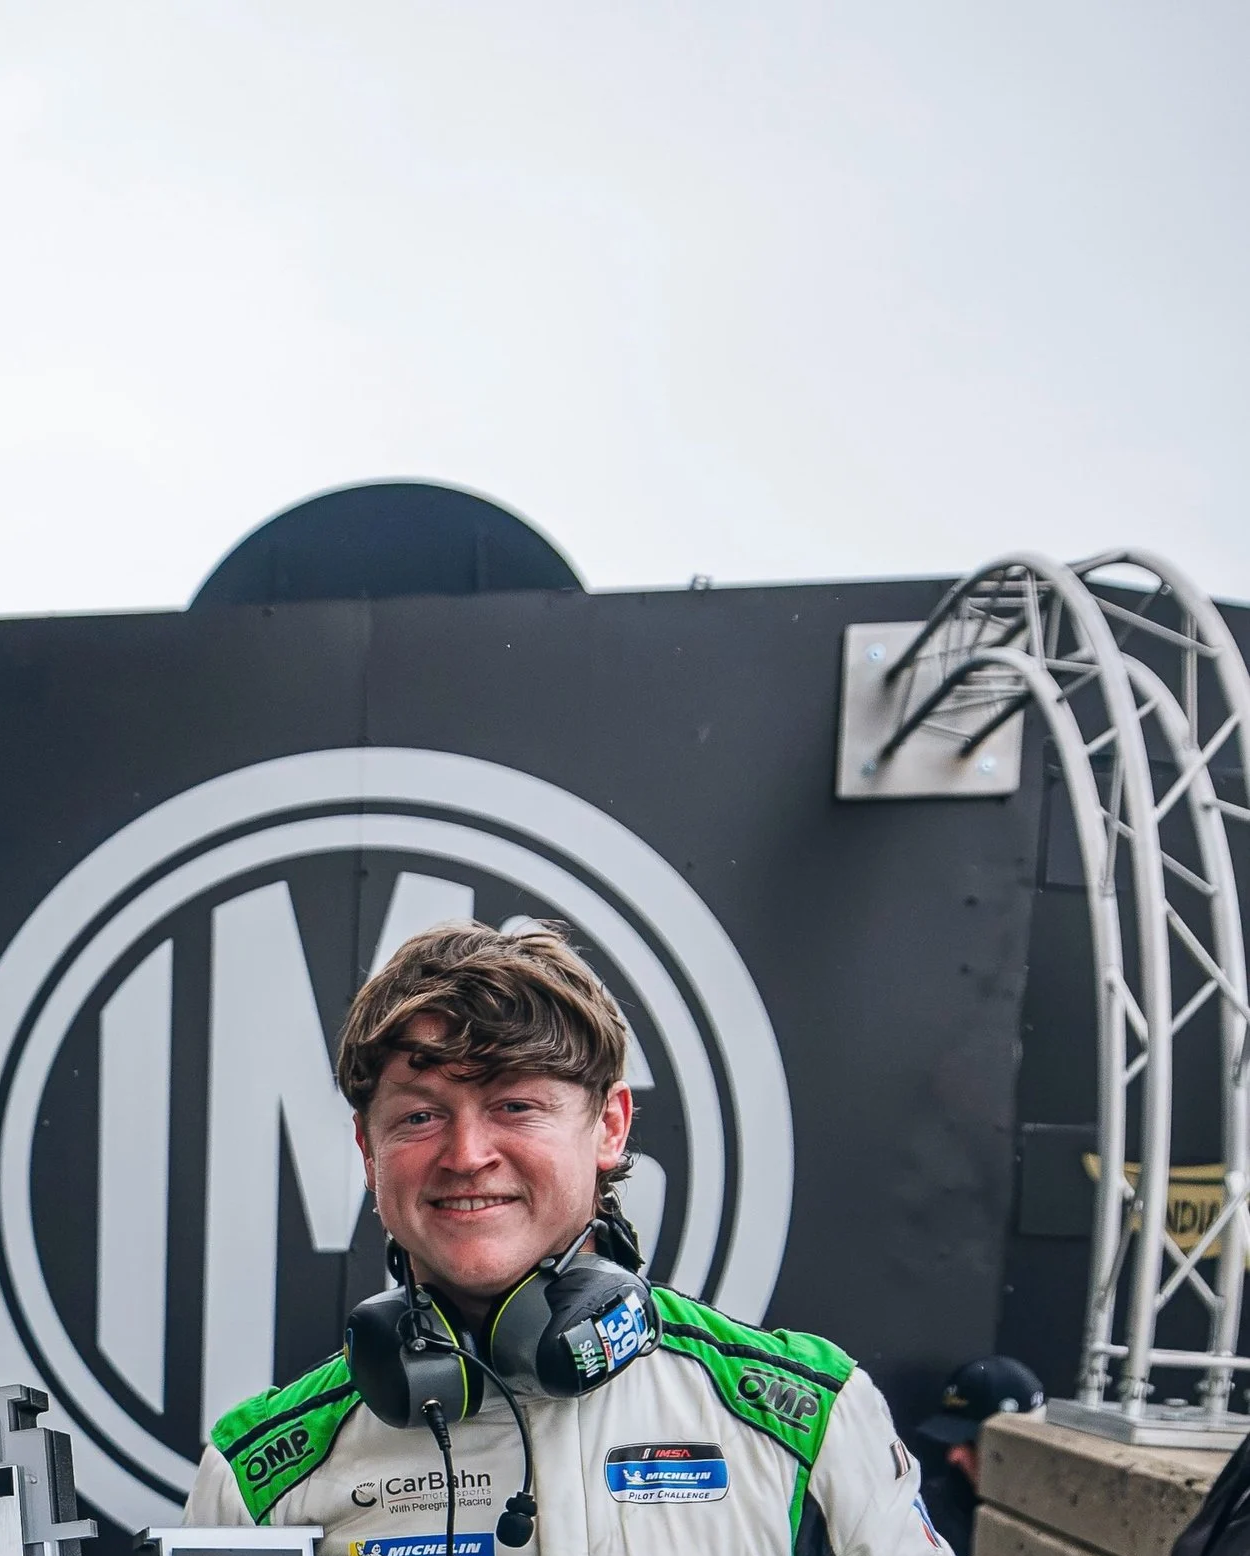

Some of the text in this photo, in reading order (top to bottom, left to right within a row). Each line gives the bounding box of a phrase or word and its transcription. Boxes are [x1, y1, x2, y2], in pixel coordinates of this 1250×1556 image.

[607, 1308, 639, 1361] 39
[578, 1339, 601, 1378] SEAN
[737, 1374, 819, 1421] OMP
[246, 1429, 310, 1481] OMP
[654, 1449, 691, 1459] IMSA
[646, 1471, 711, 1481] MICHELIN
[422, 1487, 491, 1500] motosports
[628, 1490, 711, 1501] PILOT CHALLENGE
[389, 1503, 411, 1514] With
[459, 1496, 492, 1507] Racing
